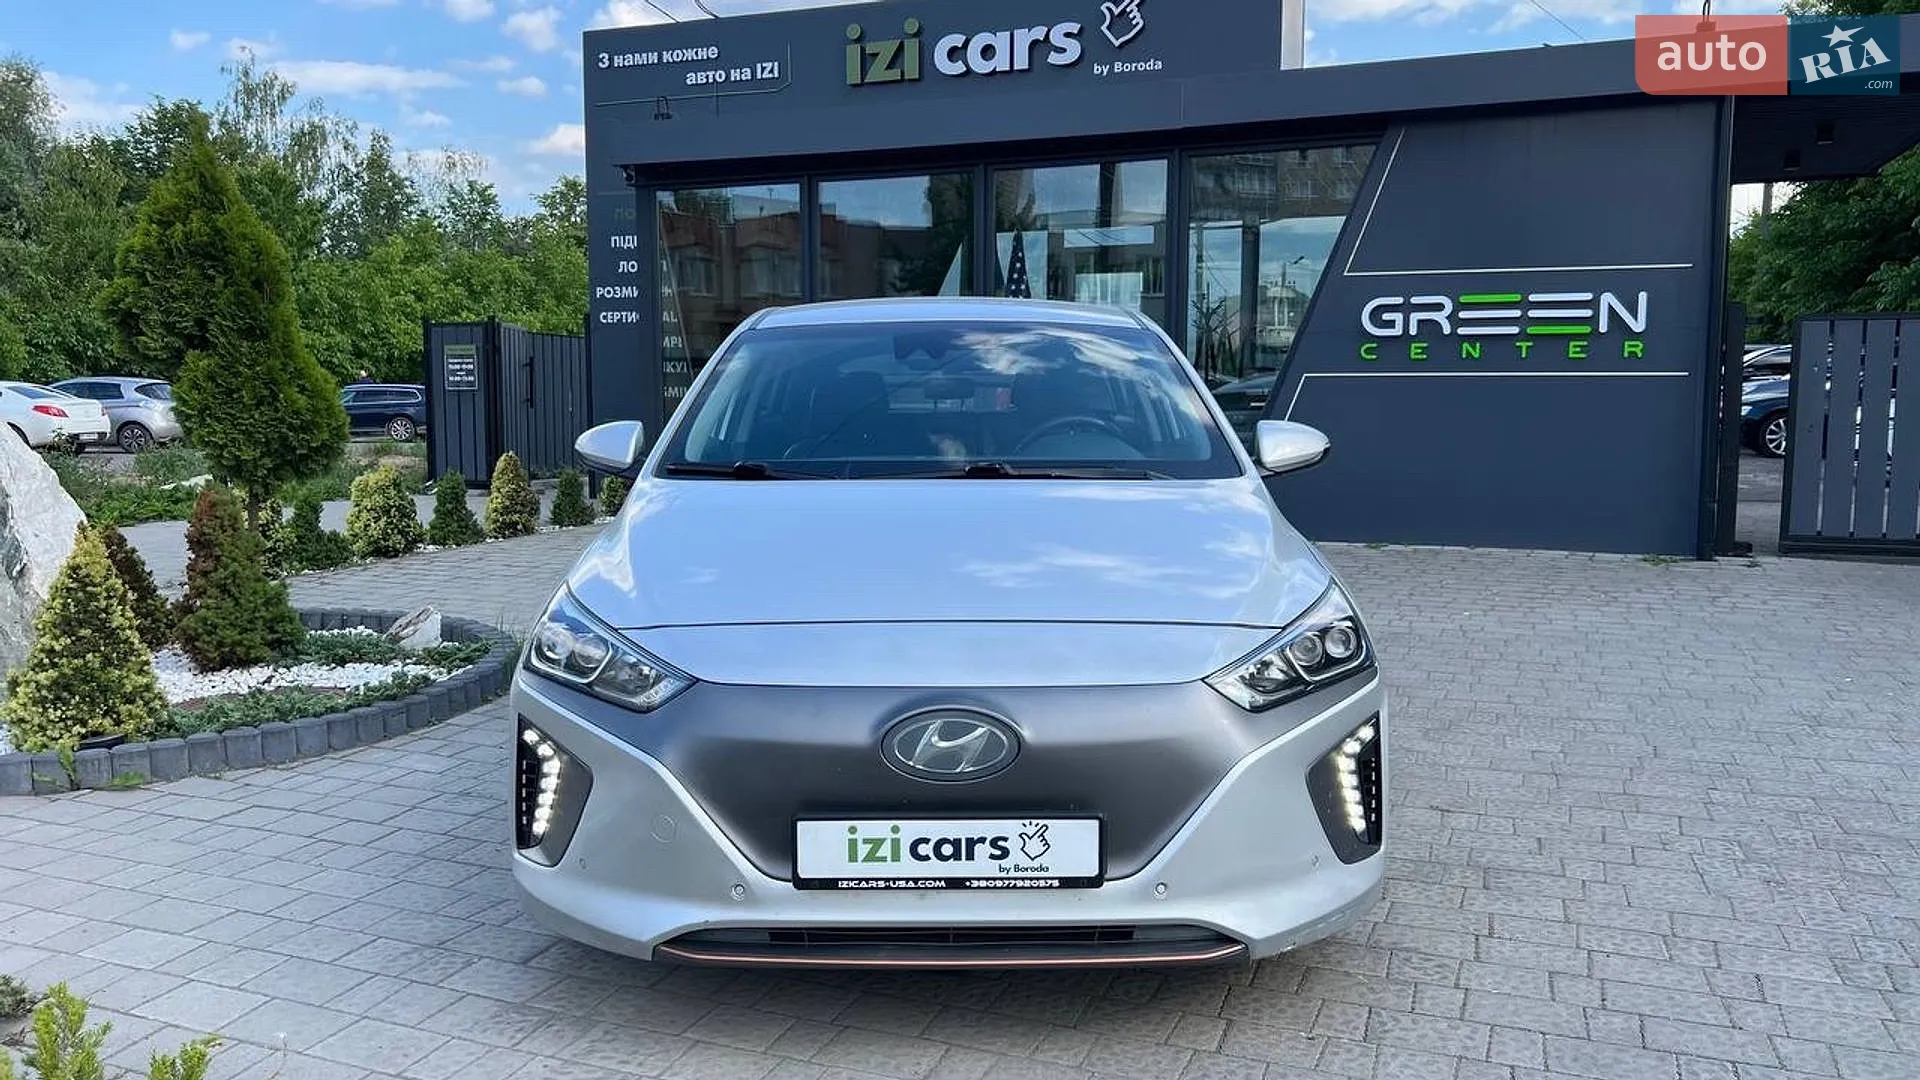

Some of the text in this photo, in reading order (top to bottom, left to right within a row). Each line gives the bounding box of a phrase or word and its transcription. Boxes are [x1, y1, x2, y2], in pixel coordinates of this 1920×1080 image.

[613, 51, 658, 68] нами
[662, 46, 719, 63] кожне
[846, 18, 1082, 85] izi cars
[686, 62, 779, 85] авто на IZI
[1093, 58, 1163, 77] by Boroda
[618, 261, 638, 273] ЛО
[600, 311, 640, 323] СЕРТИ
[1361, 290, 1648, 336] GREEN
[1360, 340, 1645, 360] CENTER
[847, 824, 1011, 863] izi cars
[998, 864, 1050, 873] by Boroda
